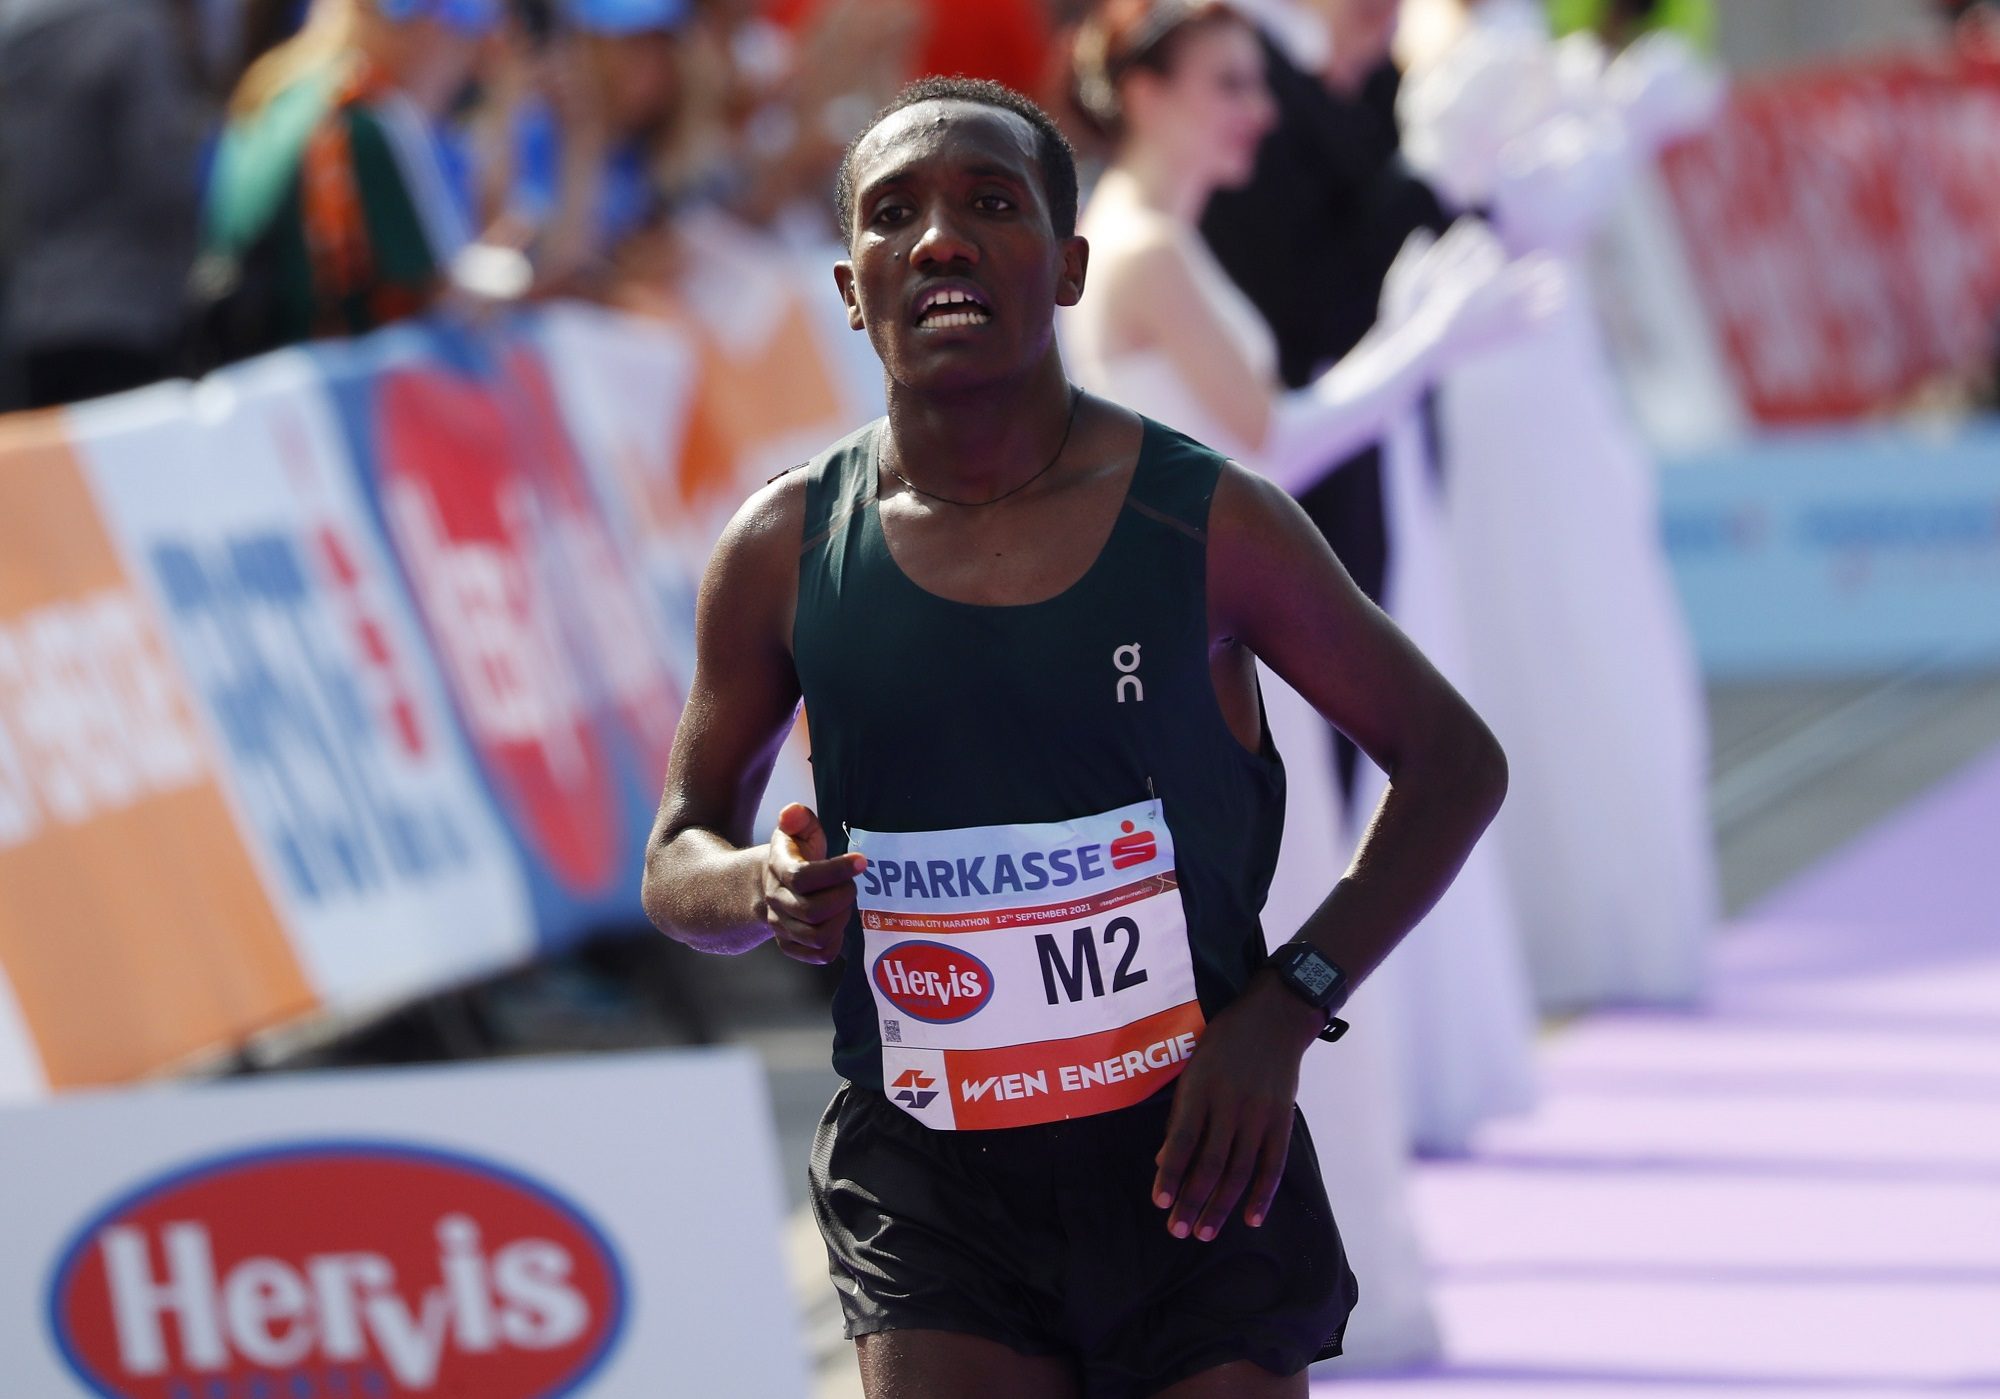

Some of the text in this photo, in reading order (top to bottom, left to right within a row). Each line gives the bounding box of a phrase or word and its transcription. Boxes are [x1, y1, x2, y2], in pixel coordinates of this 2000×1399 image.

[863, 844, 1105, 898] SPARKASSE
[899, 918, 925, 927] VIENNA
[926, 920, 942, 928] CITY
[943, 917, 990, 928] MARATHON
[1015, 908, 1068, 922] SEPTEMBER
[1069, 903, 1092, 914] 2021
[883, 959, 982, 1006] Hervis
[1034, 916, 1149, 1005] M2
[961, 1031, 1197, 1102] WIEN ENERGIE
[100, 1212, 591, 1391] Hervis
